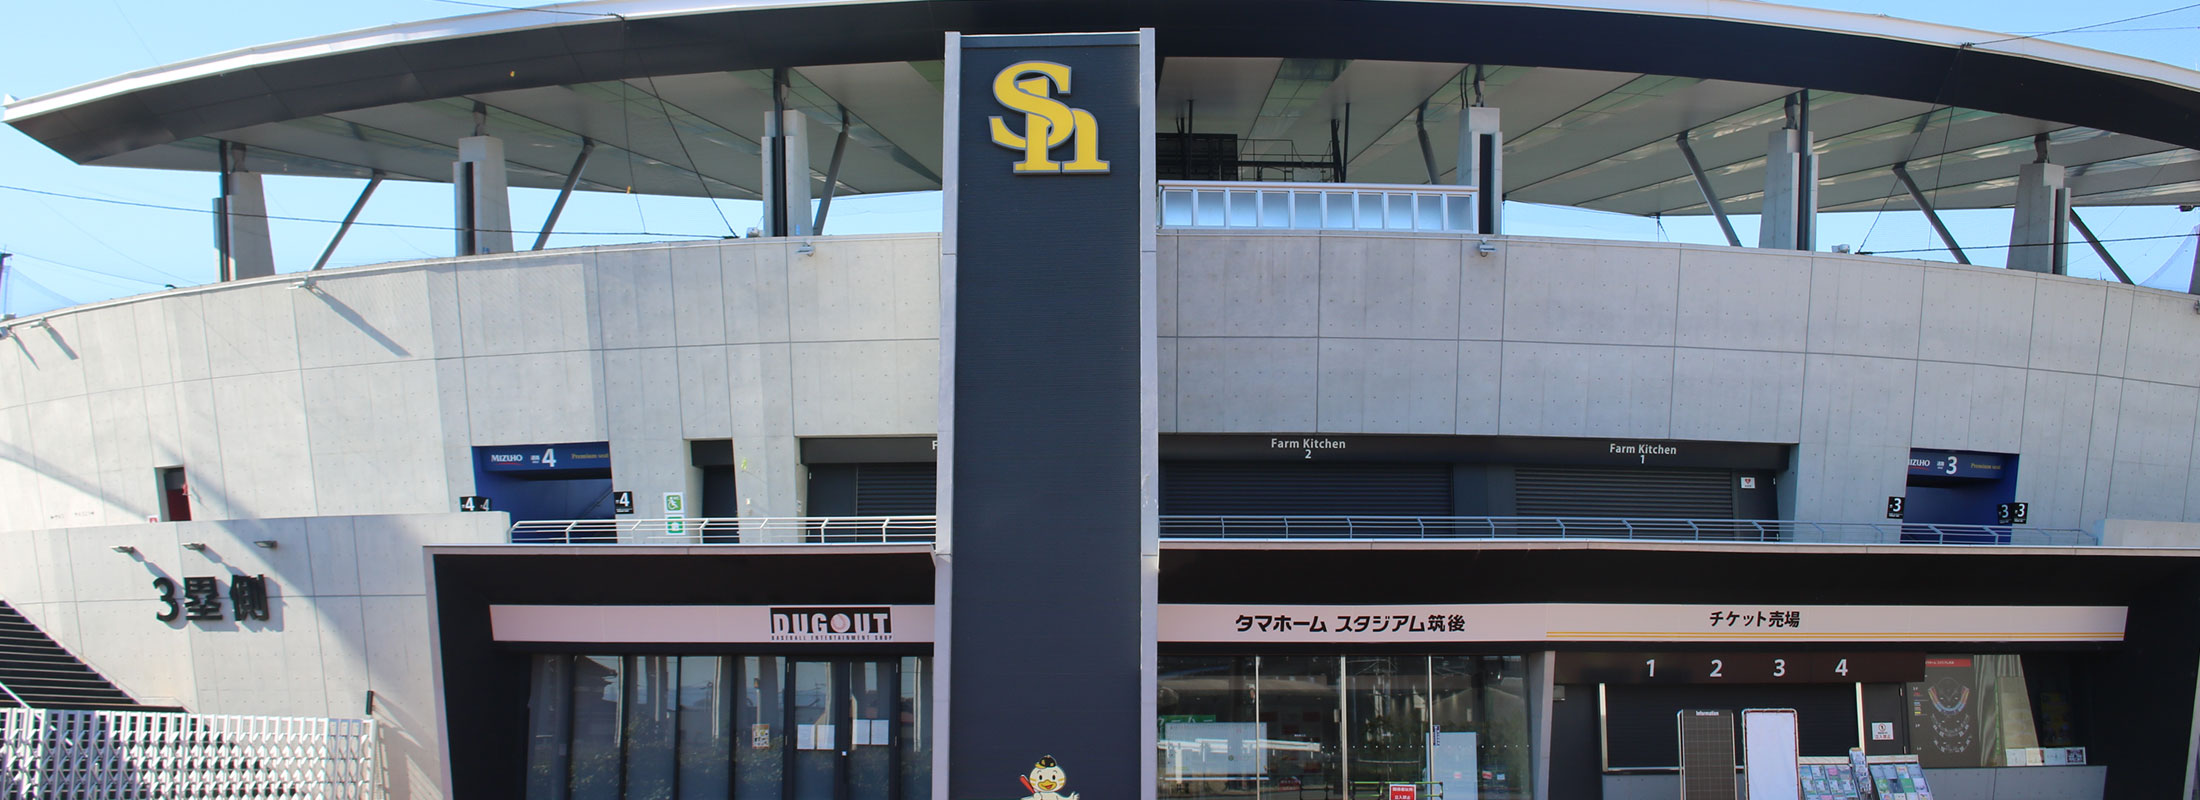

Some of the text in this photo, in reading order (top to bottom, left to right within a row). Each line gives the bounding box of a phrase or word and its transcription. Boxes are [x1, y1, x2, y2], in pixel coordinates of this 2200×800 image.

[1271, 438, 1346, 449] Farm Kitchen
[1609, 443, 1677, 455] Farm Kitchen
[490, 454, 524, 463] MIZUHO
[541, 448, 557, 468] 4
[1304, 449, 1312, 459] 2
[1640, 454, 1645, 464] 1
[1908, 458, 1931, 467] IZUHO
[1945, 456, 1958, 475] 3
[465, 497, 475, 511] 4
[483, 498, 490, 511] 4
[619, 492, 630, 507] 4
[1893, 498, 1902, 512] 3
[2001, 504, 2009, 518] 3
[2017, 503, 2026, 518] 3
[152, 574, 270, 622] 3塁側
[773, 613, 888, 633] DUGOUT
[1235, 614, 1466, 632] タマホーム スタジアム筑後
[1709, 611, 1801, 628] チケット売場
[1646, 658, 1849, 678] 1 2 3 4
